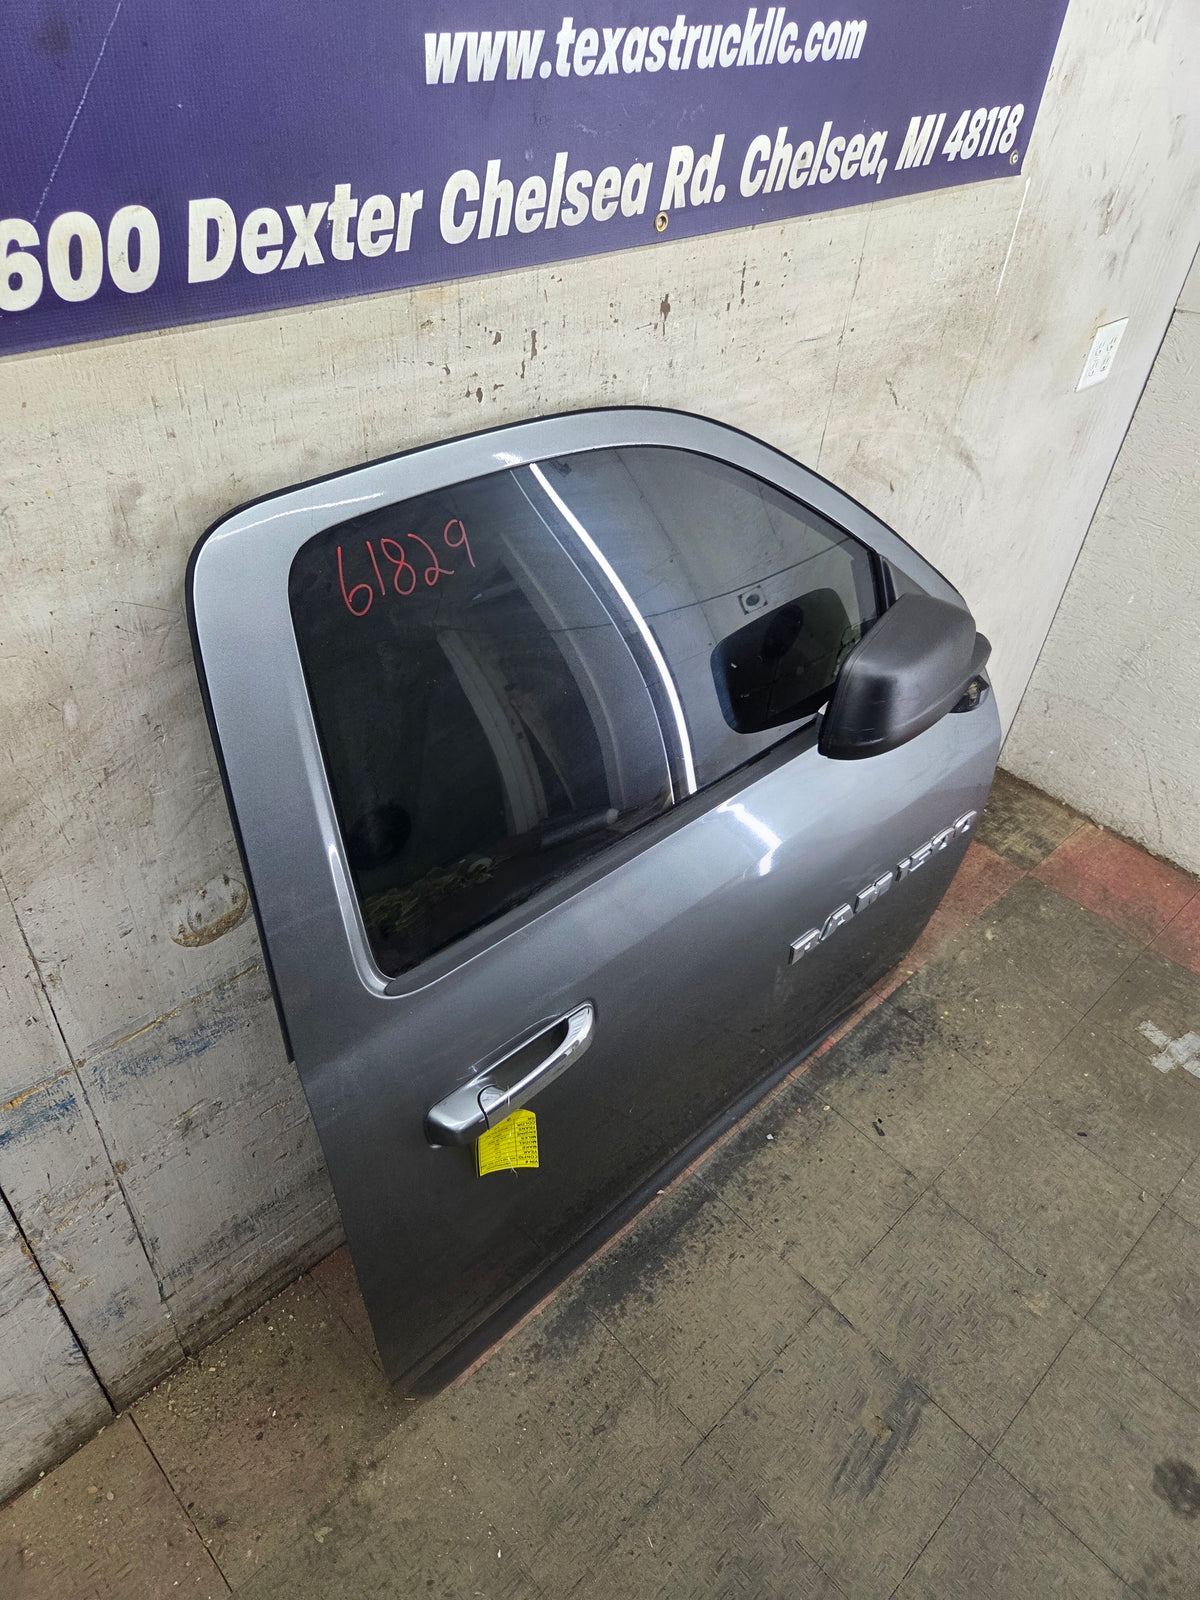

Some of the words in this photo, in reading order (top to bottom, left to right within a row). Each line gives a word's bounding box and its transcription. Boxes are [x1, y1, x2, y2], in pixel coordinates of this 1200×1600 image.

[424, 7, 867, 85] www.texastruckllc.com
[188, 183, 423, 283] Dexter
[439, 152, 653, 246] Chelsea
[660, 133, 726, 211] Rd.
[740, 120, 888, 198] Chelsea,
[894, 113, 947, 171] MI
[942, 103, 1025, 162] 48118
[337, 518, 476, 617] 61829
[787, 870, 893, 966] RAM
[894, 809, 978, 883] 1500
